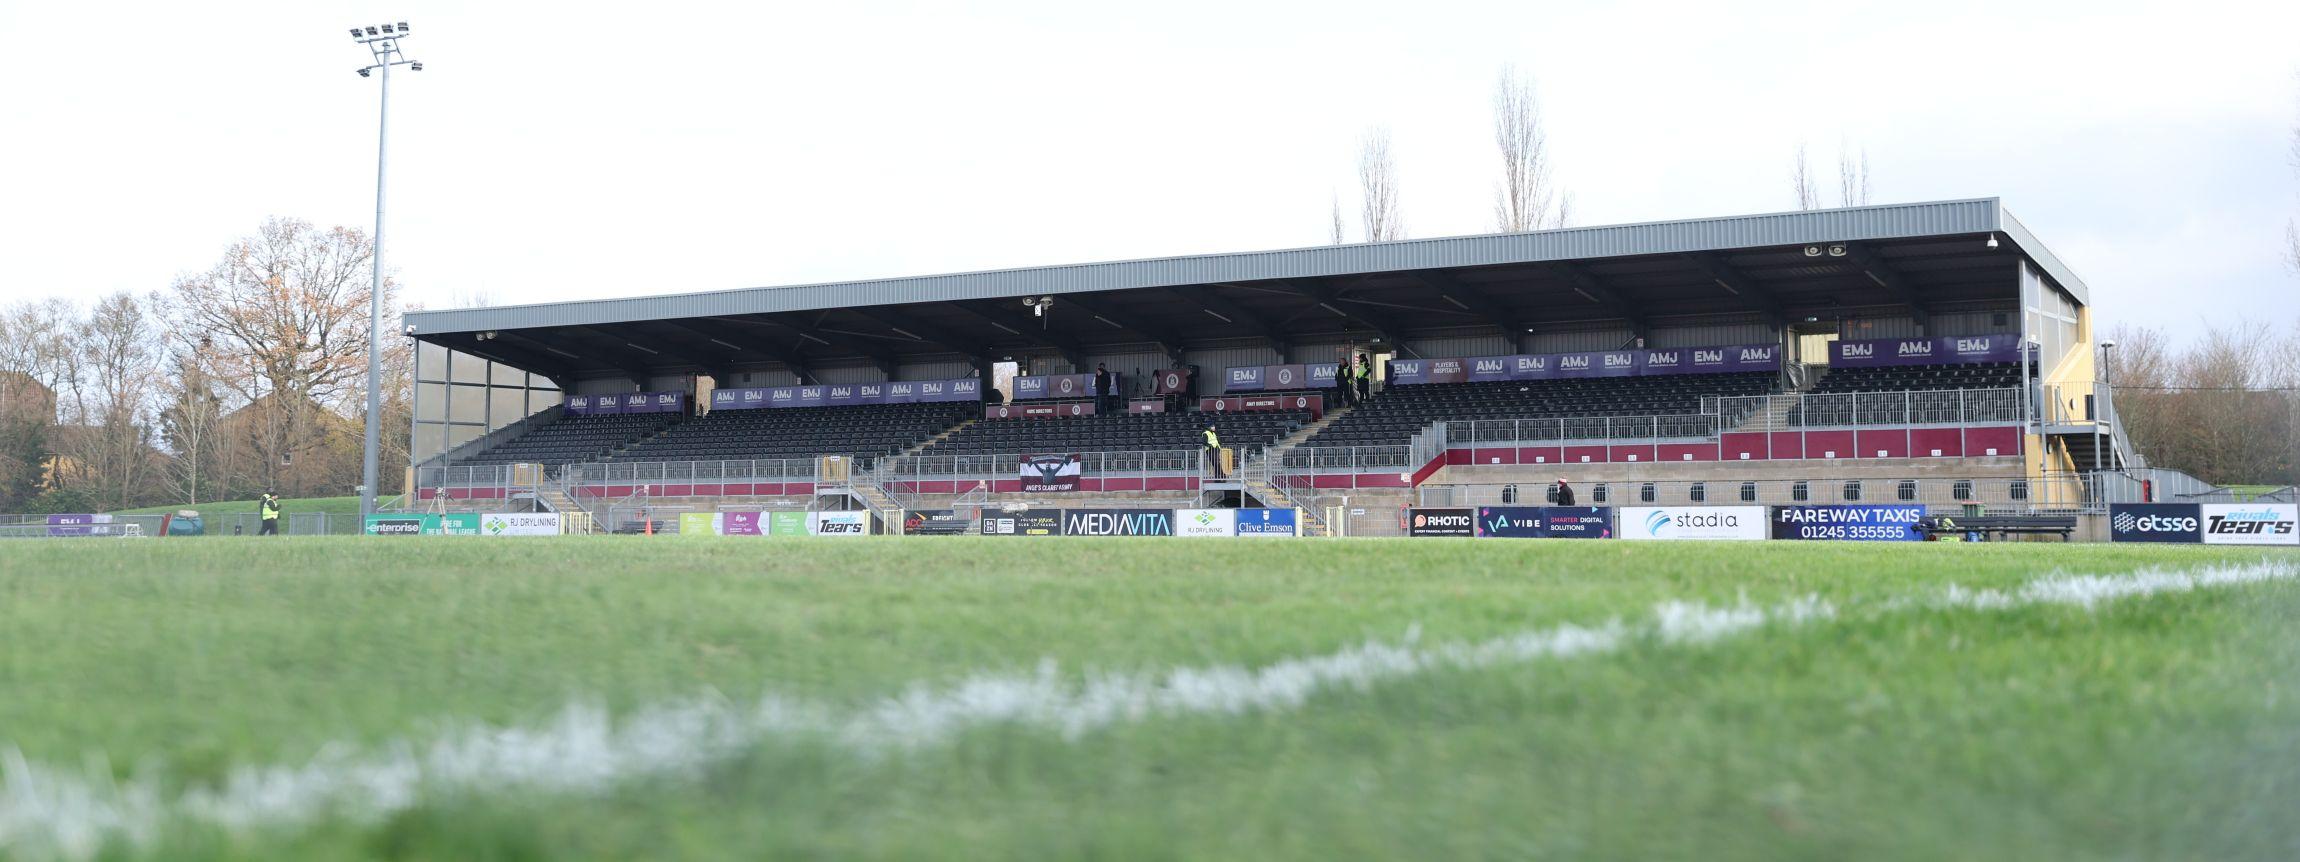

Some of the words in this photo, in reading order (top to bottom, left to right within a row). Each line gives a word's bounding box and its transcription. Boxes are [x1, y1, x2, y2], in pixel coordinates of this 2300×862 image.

[1842, 344, 1872, 356] EMJ
[1898, 341, 1931, 354] AMJ
[1957, 339, 1990, 352] EMJ
[1648, 352, 1678, 364] AMJ
[1694, 350, 1723, 362] EMJ
[1740, 348, 1771, 360] AMJ
[1519, 358, 1545, 369] EMJ
[1560, 356, 1589, 368] AMJ
[1604, 354, 1632, 365] EMJ
[1394, 364, 1419, 374] EMJ
[1476, 360, 1503, 372] AMJ
[1233, 370, 1256, 380] EMJ
[891, 384, 912, 394] AMJ
[922, 383, 942, 393] EMJ
[954, 382, 975, 392] AMJ
[1020, 379, 1040, 389] EMJ
[745, 391, 763, 400] EMJ
[773, 390, 792, 399] AMJ
[802, 388, 821, 398] EMJ
[831, 387, 850, 397] AMJ
[861, 386, 880, 396] EMJ
[600, 397, 616, 406] EMJ
[628, 395, 646, 404] AMJ
[659, 394, 676, 403] EMJ
[716, 392, 735, 401] AMJ
[571, 398, 587, 407] AMJ
[1428, 516, 1470, 526] RHOTIC
[1677, 512, 1738, 528] stadia
[1781, 509, 1870, 523] FAREWAY
[1873, 509, 1920, 522] TAXIS
[510, 518, 518, 526] RJ
[521, 518, 556, 526] DRYLINING
[821, 520, 862, 533] Tears
[1068, 514, 1170, 535] MEDIAVITA
[1239, 522, 1262, 532] Clive
[1264, 523, 1292, 532] Emson
[2208, 516, 2294, 534] Tears
[367, 523, 419, 532] enterprise
[1801, 526, 1846, 538] 01245
[1849, 526, 1905, 538] 355555
